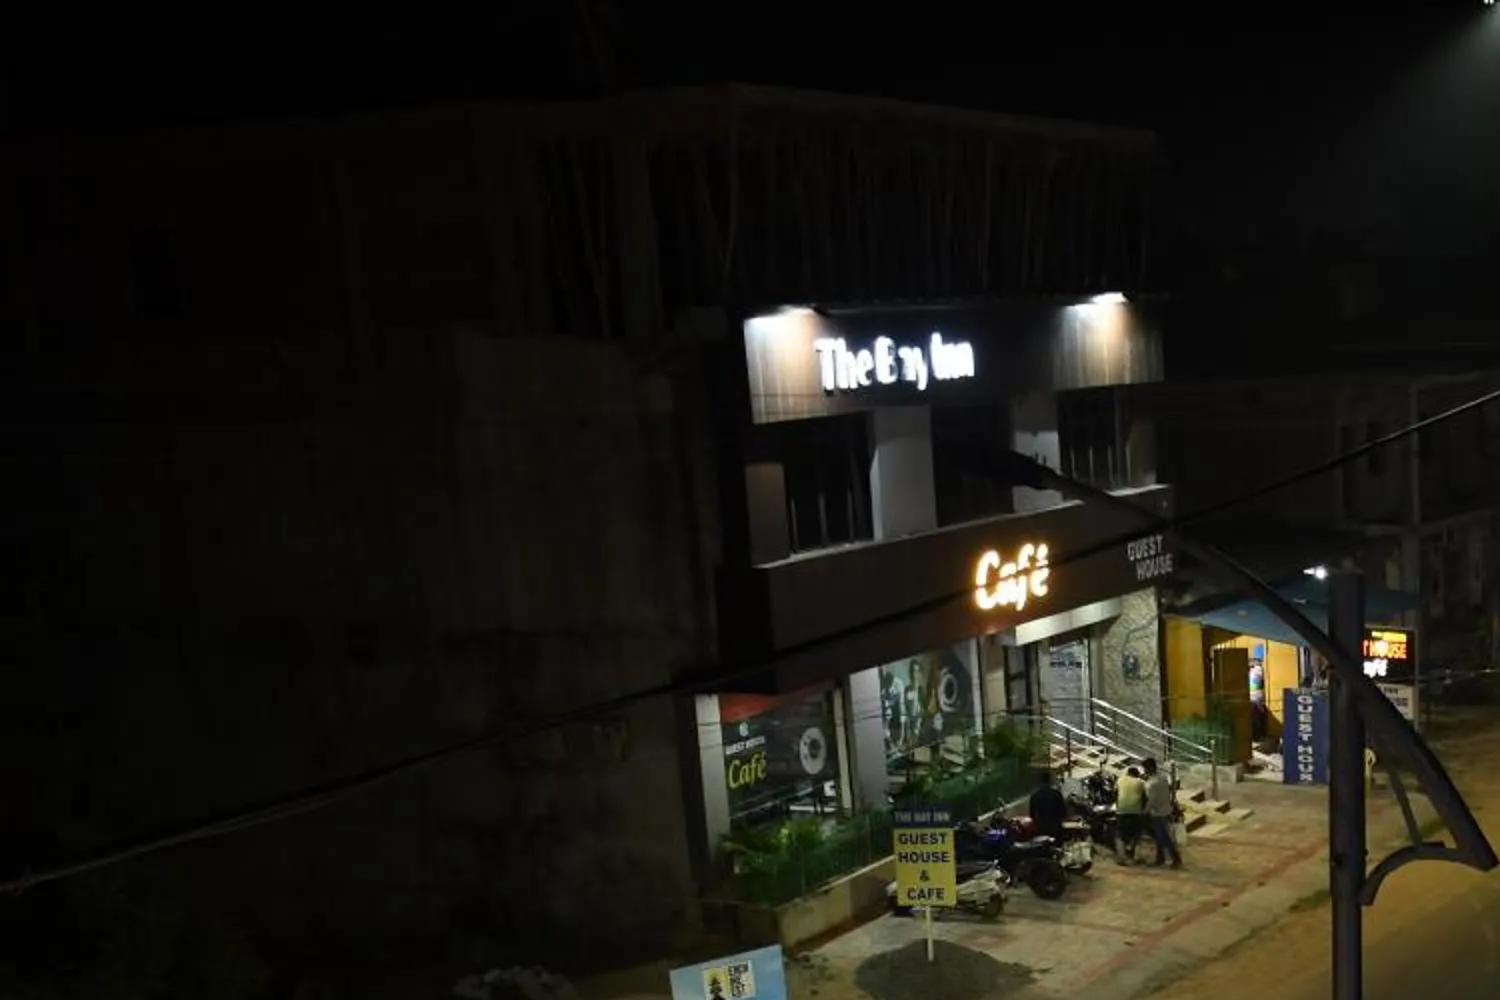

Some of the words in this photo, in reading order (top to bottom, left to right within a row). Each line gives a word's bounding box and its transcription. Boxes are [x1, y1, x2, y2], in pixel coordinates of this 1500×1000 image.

[813, 337, 873, 390] The
[930, 332, 975, 380] Inn
[1127, 534, 1163, 561] GUEST
[1135, 553, 1174, 581] HOUSE
[898, 832, 947, 845] GUEST
[898, 851, 950, 864] HOUSE
[907, 887, 945, 901] CAFE
